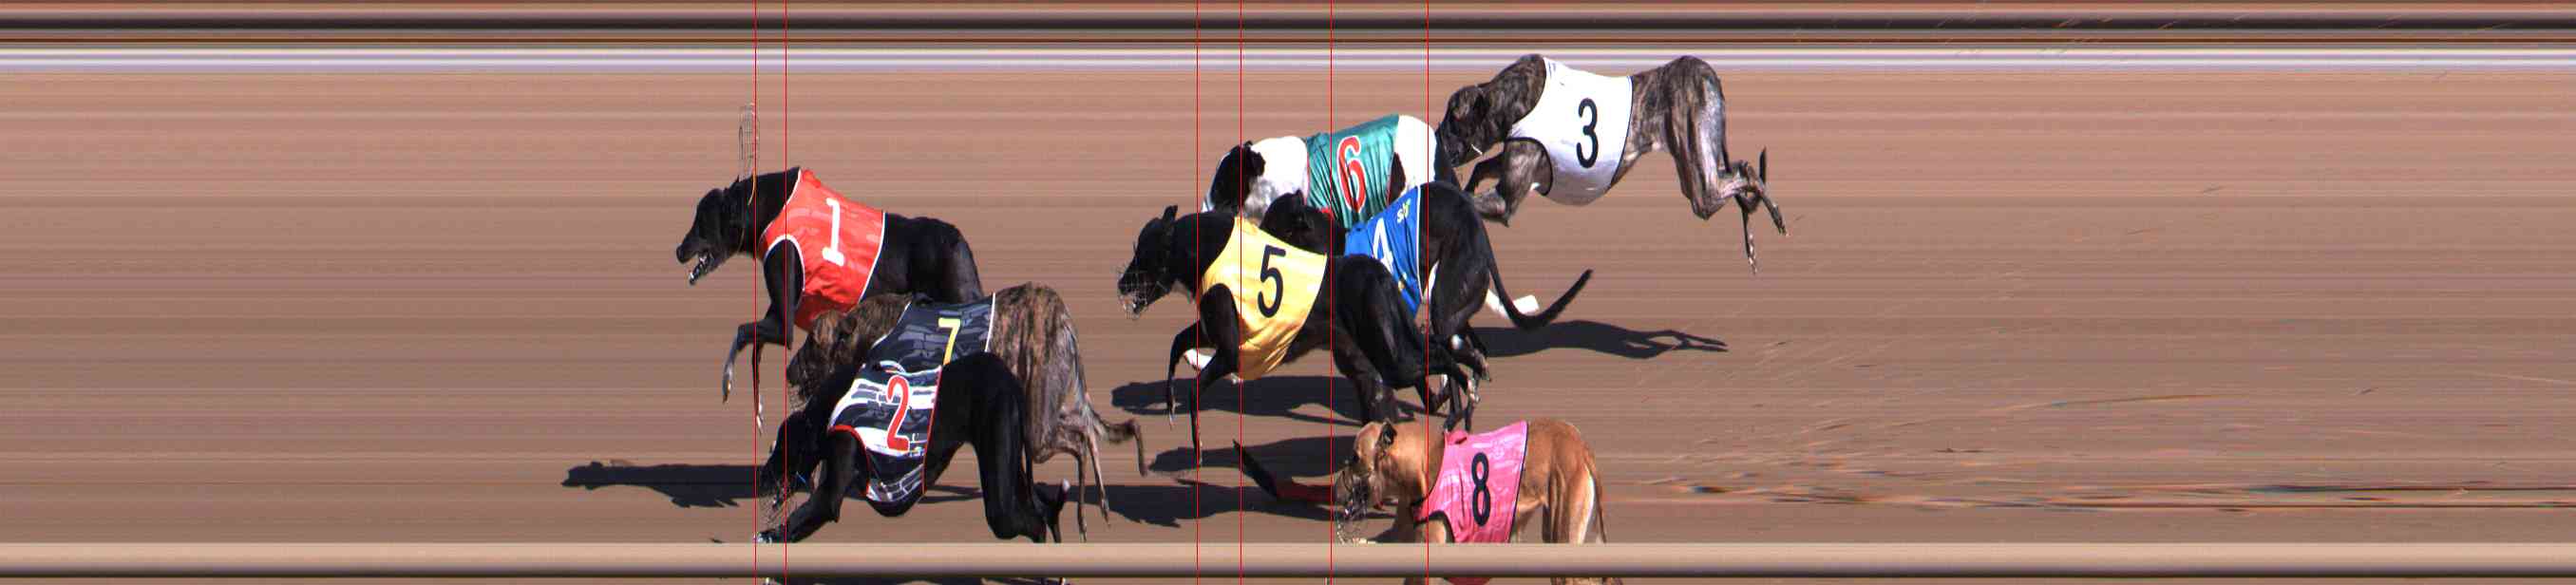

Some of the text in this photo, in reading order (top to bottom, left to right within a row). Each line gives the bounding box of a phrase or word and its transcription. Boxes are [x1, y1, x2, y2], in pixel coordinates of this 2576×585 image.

[1576, 98, 1599, 169] 3
[1337, 136, 1367, 214] 6
[823, 198, 845, 266] 1
[1373, 217, 1394, 274] 4
[1257, 245, 1286, 318] 5
[938, 317, 961, 365] 7
[886, 375, 911, 453] 2
[1471, 452, 1491, 526] 8
